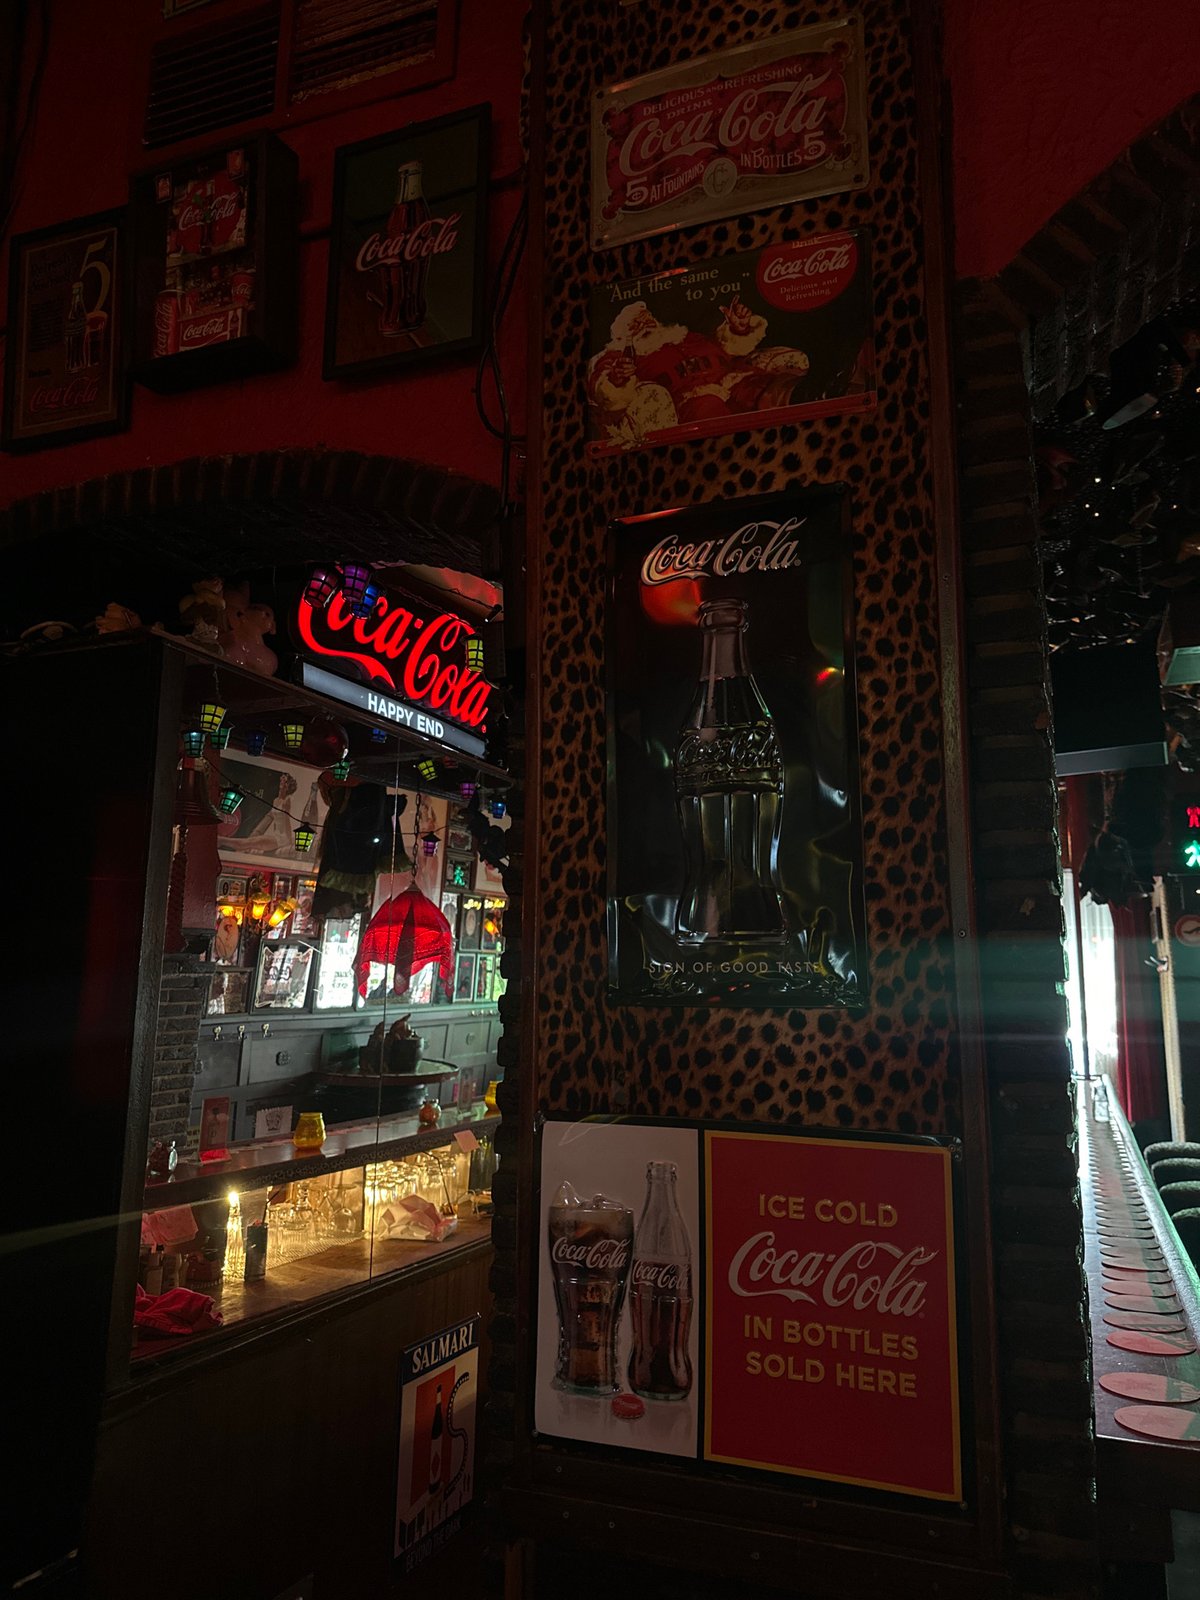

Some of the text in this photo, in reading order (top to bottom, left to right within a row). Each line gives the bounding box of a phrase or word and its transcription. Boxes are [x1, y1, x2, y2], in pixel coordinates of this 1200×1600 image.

[642, 86, 707, 117] DELICIOUS
[724, 64, 803, 91] REFRESHING
[667, 98, 714, 121] DRINK
[741, 151, 752, 168] IN
[753, 146, 803, 169] BOTTLES
[649, 184, 663, 204] AT
[662, 161, 705, 199] FOUNTAINS
[355, 211, 463, 273] Coca-Cola
[762, 242, 854, 284] Coca-Cola
[648, 277, 673, 294] the
[680, 268, 720, 287] same
[686, 288, 704, 302] to
[780, 276, 839, 294] Delicious and
[640, 516, 808, 586] Coca-Cola
[367, 692, 445, 739] HAPPY END
[648, 960, 821, 975] SIGN OF GOOD TASTE
[759, 1192, 899, 1229] ICE COLD
[552, 1236, 632, 1269] Coca-Cola
[632, 1259, 691, 1290] Coca-Cola
[727, 1231, 940, 1318] Coca-Cola
[411, 1322, 474, 1375] SALMARI
[743, 1314, 920, 1361] IN BOTTLES
[744, 1350, 919, 1399] SOLD HERE
